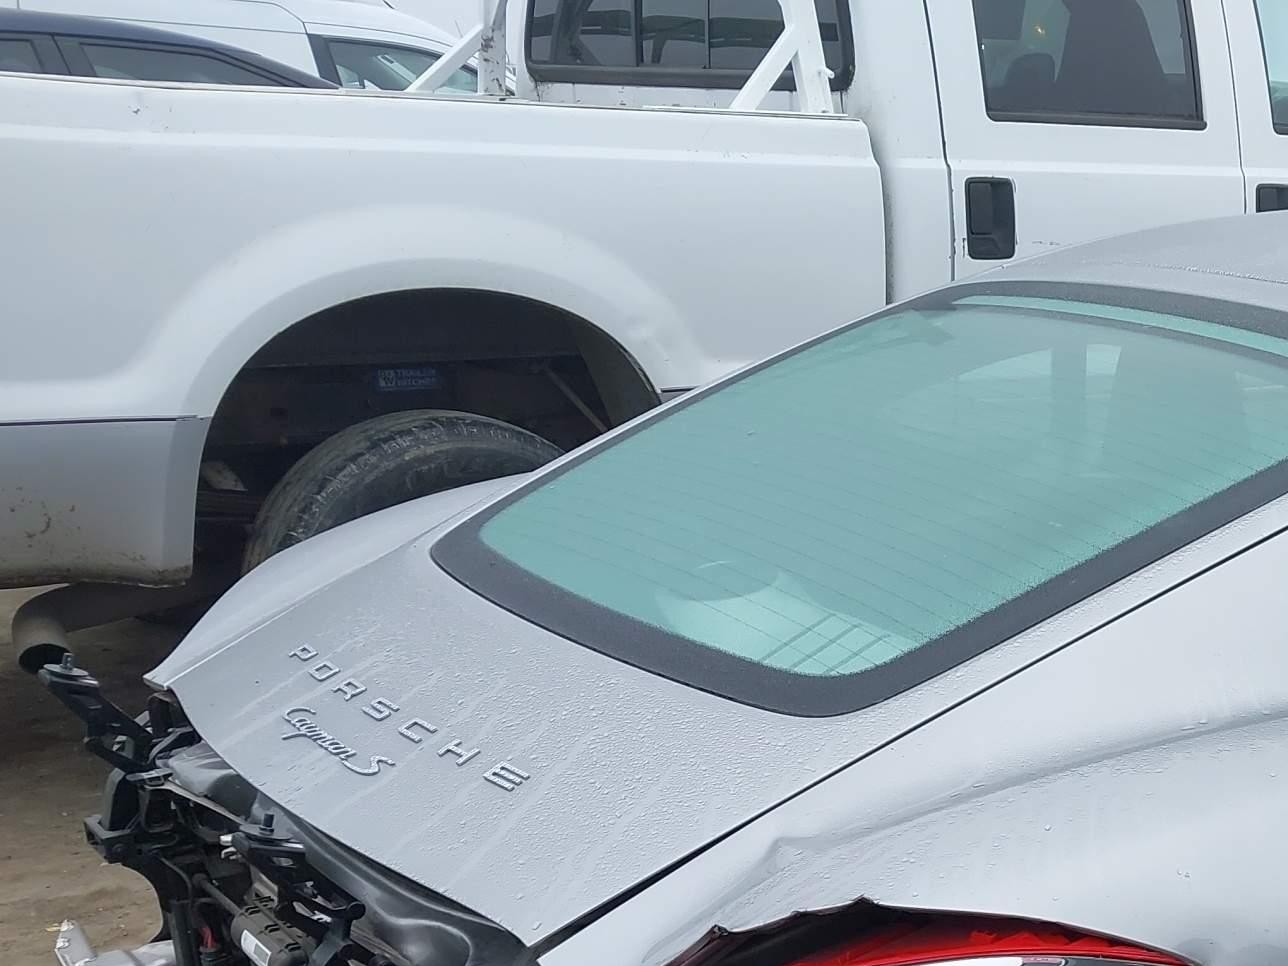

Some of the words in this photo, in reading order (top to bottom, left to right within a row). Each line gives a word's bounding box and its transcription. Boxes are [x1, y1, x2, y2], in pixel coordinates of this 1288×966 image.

[281, 706, 357, 760] Cayman
[341, 755, 396, 776] S
[288, 643, 531, 792] PORSCHE
